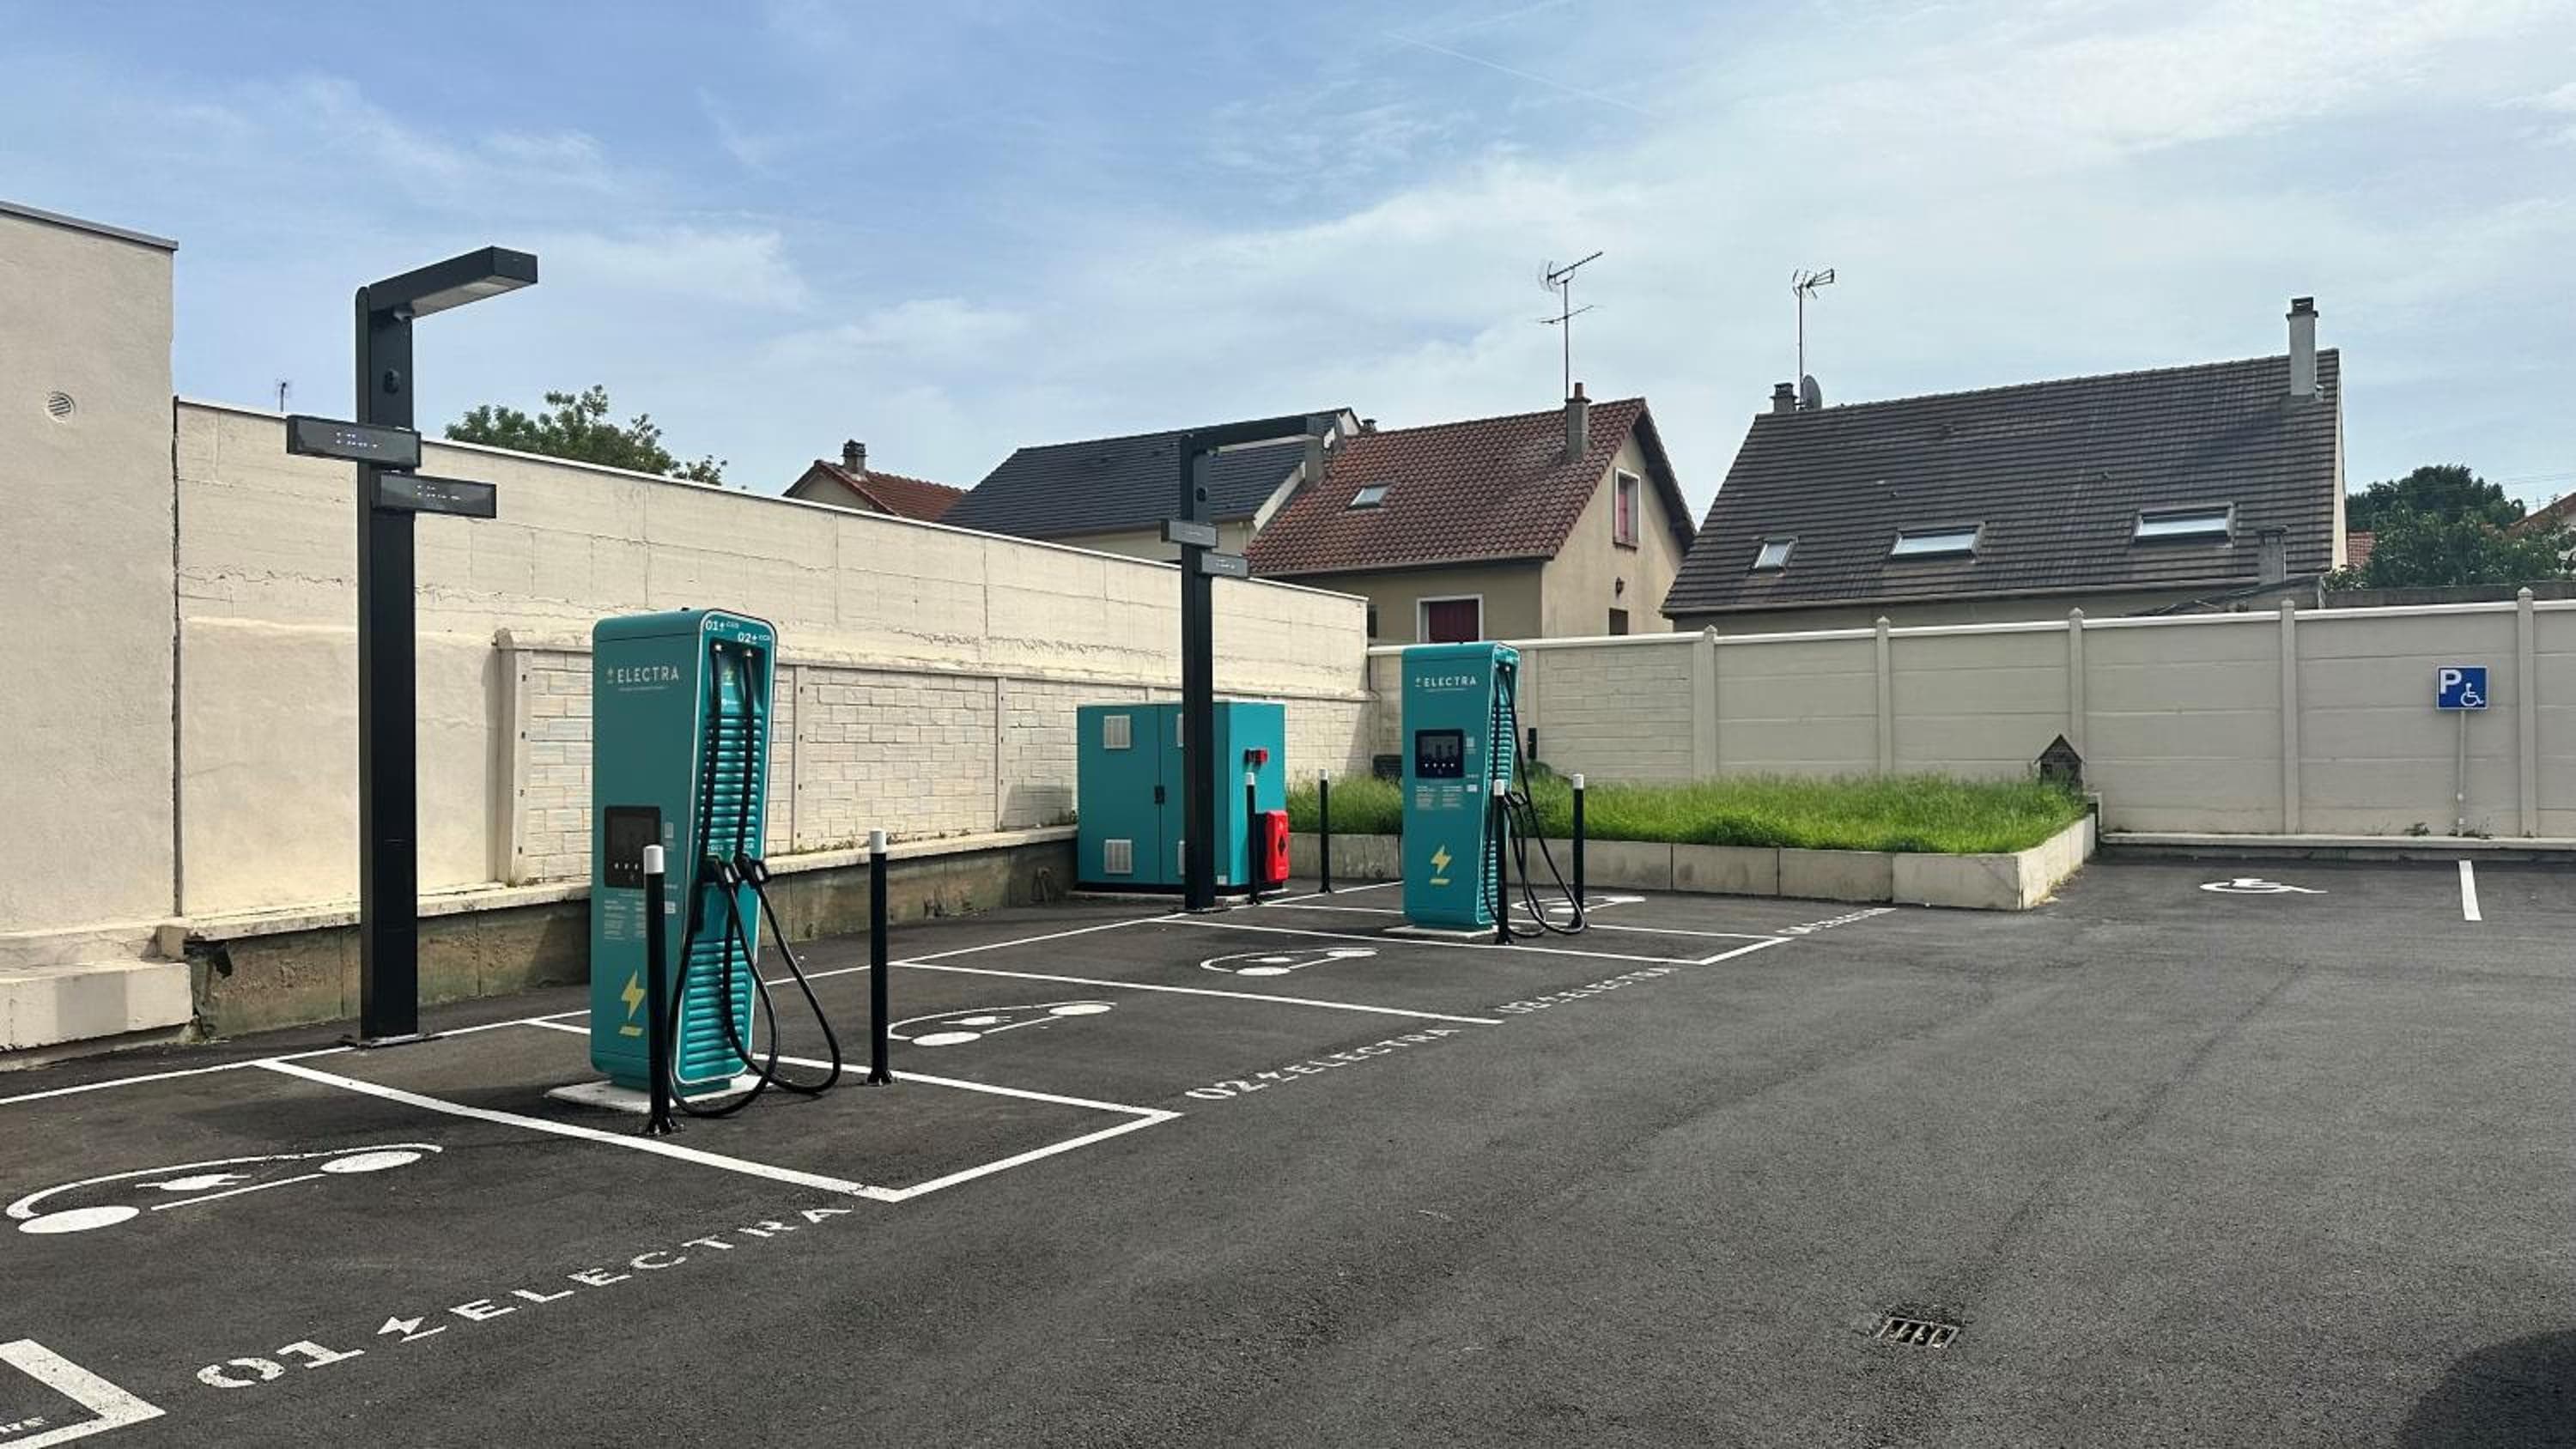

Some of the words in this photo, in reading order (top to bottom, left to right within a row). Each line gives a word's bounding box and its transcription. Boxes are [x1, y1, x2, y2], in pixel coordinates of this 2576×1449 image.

[705, 620, 719, 631] 01
[738, 632, 751, 643] 02
[617, 665, 679, 684] ELECTRA
[1425, 676, 1477, 688] ELECTRA
[2439, 669, 2462, 694] P
[1184, 1080, 1269, 1100] 02
[1283, 1028, 1461, 1074] ELECTRA
[197, 1340, 366, 1388] 01
[449, 1207, 853, 1320] ELECTRA
